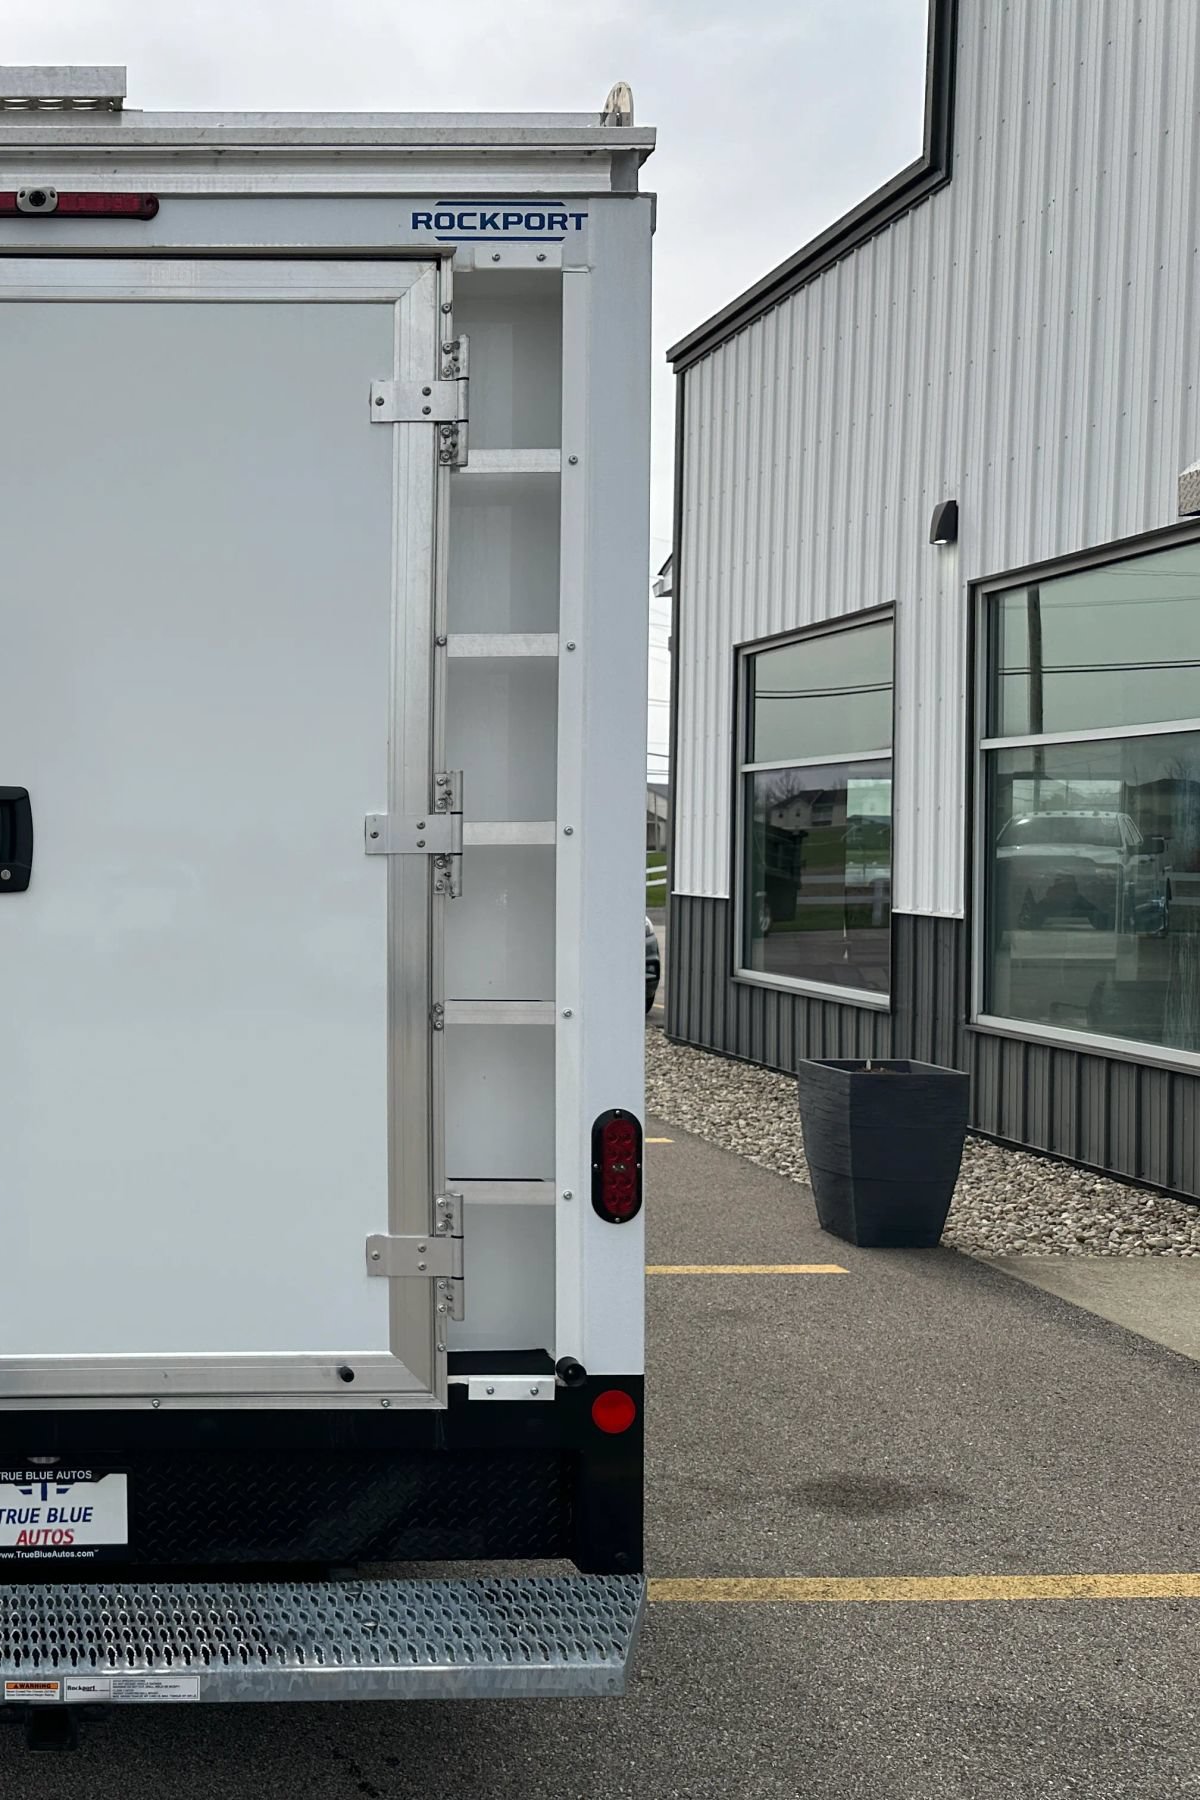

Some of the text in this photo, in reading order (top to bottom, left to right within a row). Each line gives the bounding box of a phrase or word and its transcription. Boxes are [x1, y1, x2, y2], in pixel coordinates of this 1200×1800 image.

[411, 212, 589, 230] ROCKPORT
[25, 1471, 54, 1480] BLUE
[56, 1470, 93, 1479] AUTOS
[46, 1506, 94, 1523] BLUE
[16, 1528, 75, 1546] AUTOS
